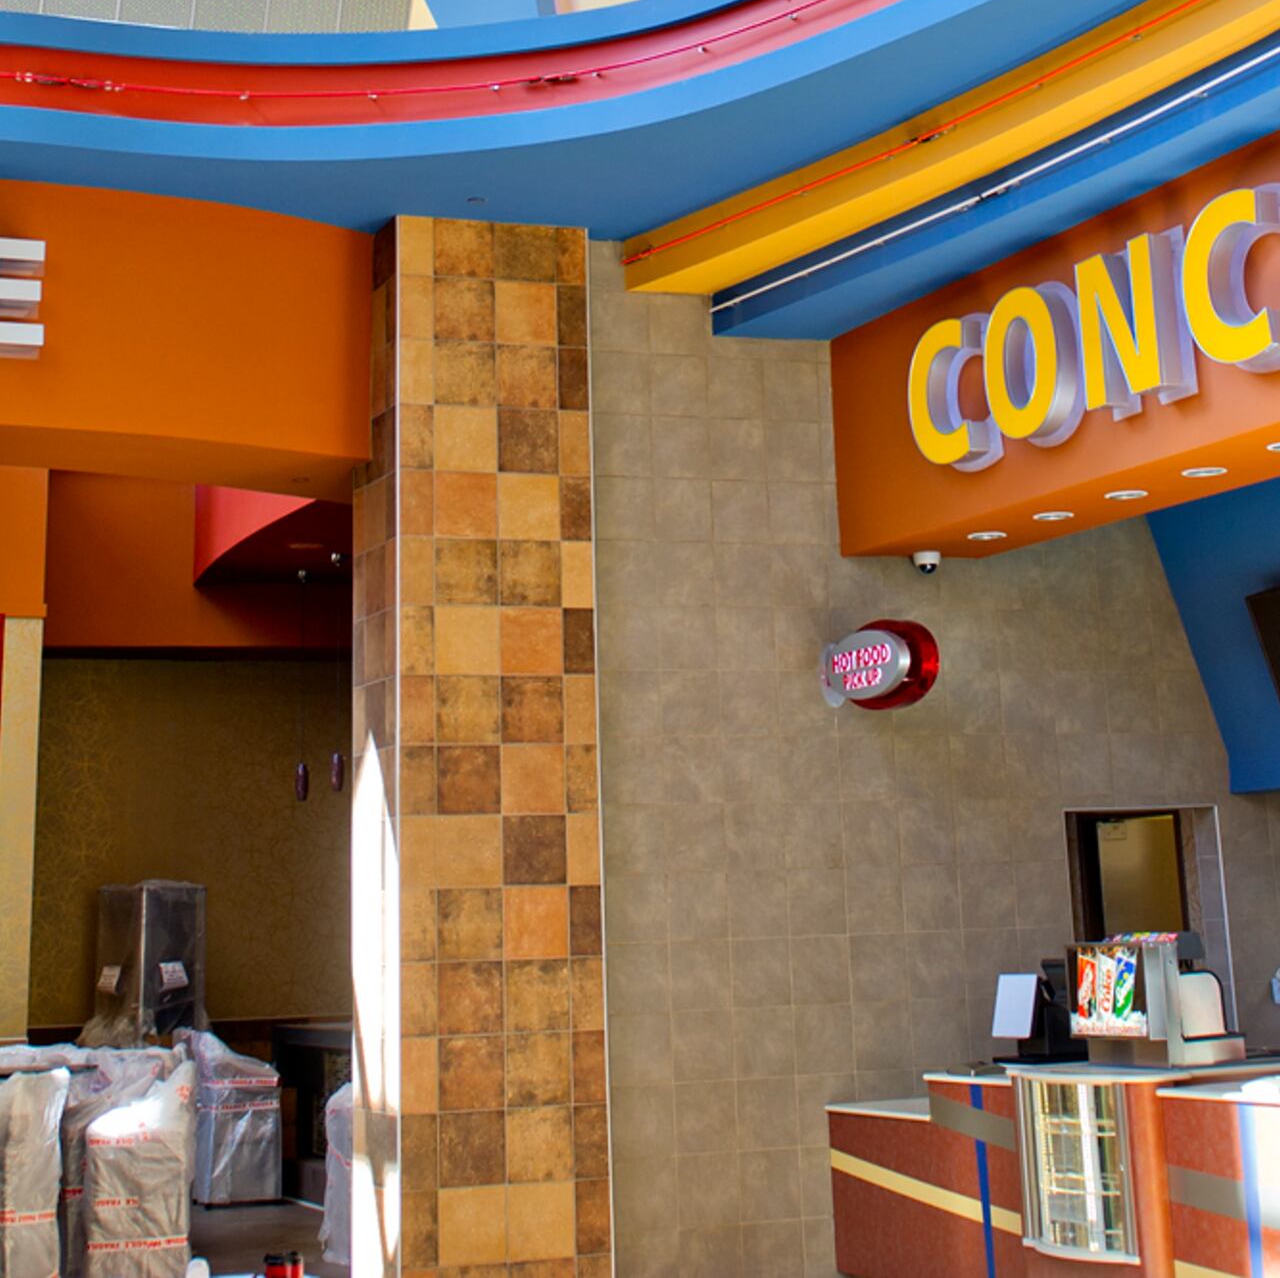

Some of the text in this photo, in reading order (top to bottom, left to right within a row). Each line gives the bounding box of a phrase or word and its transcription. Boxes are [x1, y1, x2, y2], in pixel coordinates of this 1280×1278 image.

[832, 643, 891, 674] HOT FOOD
[843, 667, 882, 690] PICK UP
